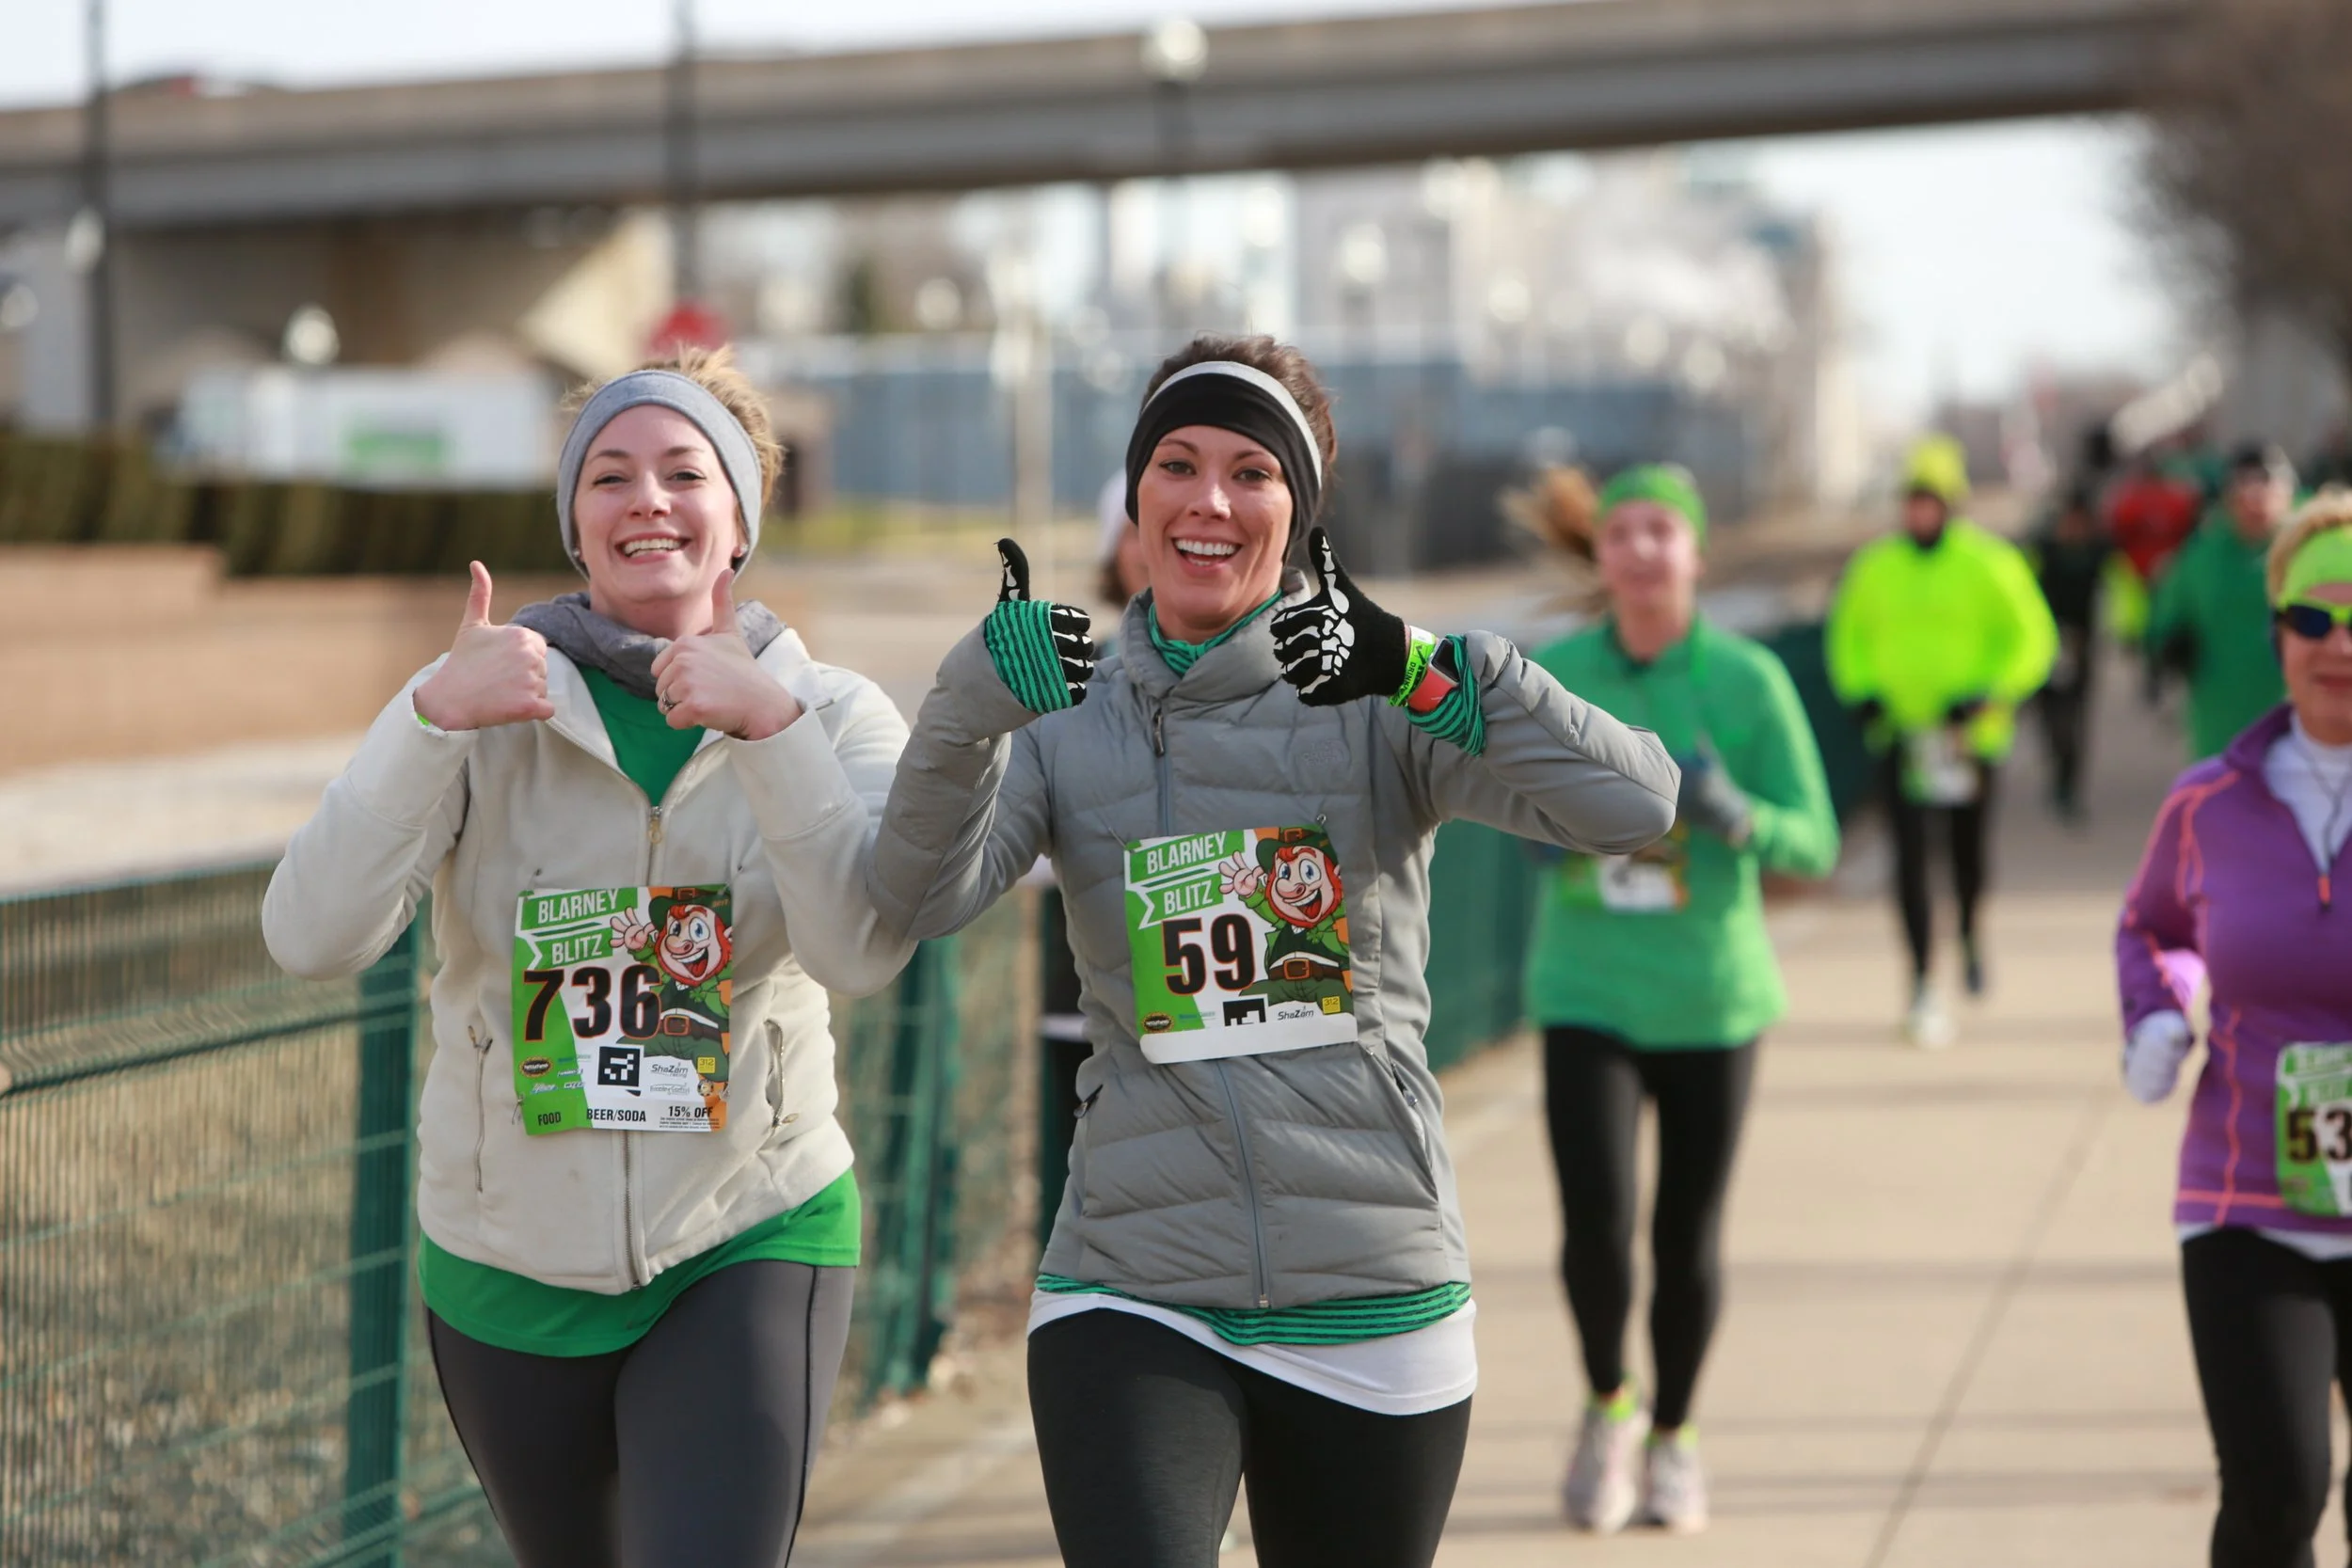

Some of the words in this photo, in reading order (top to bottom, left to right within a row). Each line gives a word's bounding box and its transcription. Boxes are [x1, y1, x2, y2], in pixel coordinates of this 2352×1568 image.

[1147, 832, 1227, 874] BLARNEY
[537, 888, 619, 924] BLARNEY
[1164, 880, 1214, 915] BLITZ
[551, 933, 603, 965] BLITZ
[1161, 913, 1256, 996] 59
[522, 962, 662, 1042] 736
[1278, 1008, 1314, 1021] ShaZam
[651, 1063, 688, 1073] ShaZam
[699, 1058, 714, 1067] 312
[537, 1111, 562, 1126] FOOD
[586, 1108, 646, 1122] BEER/SODA
[669, 1106, 691, 1117] 15%
[694, 1106, 714, 1118] OFF
[2286, 1107, 2352, 1164] 53
